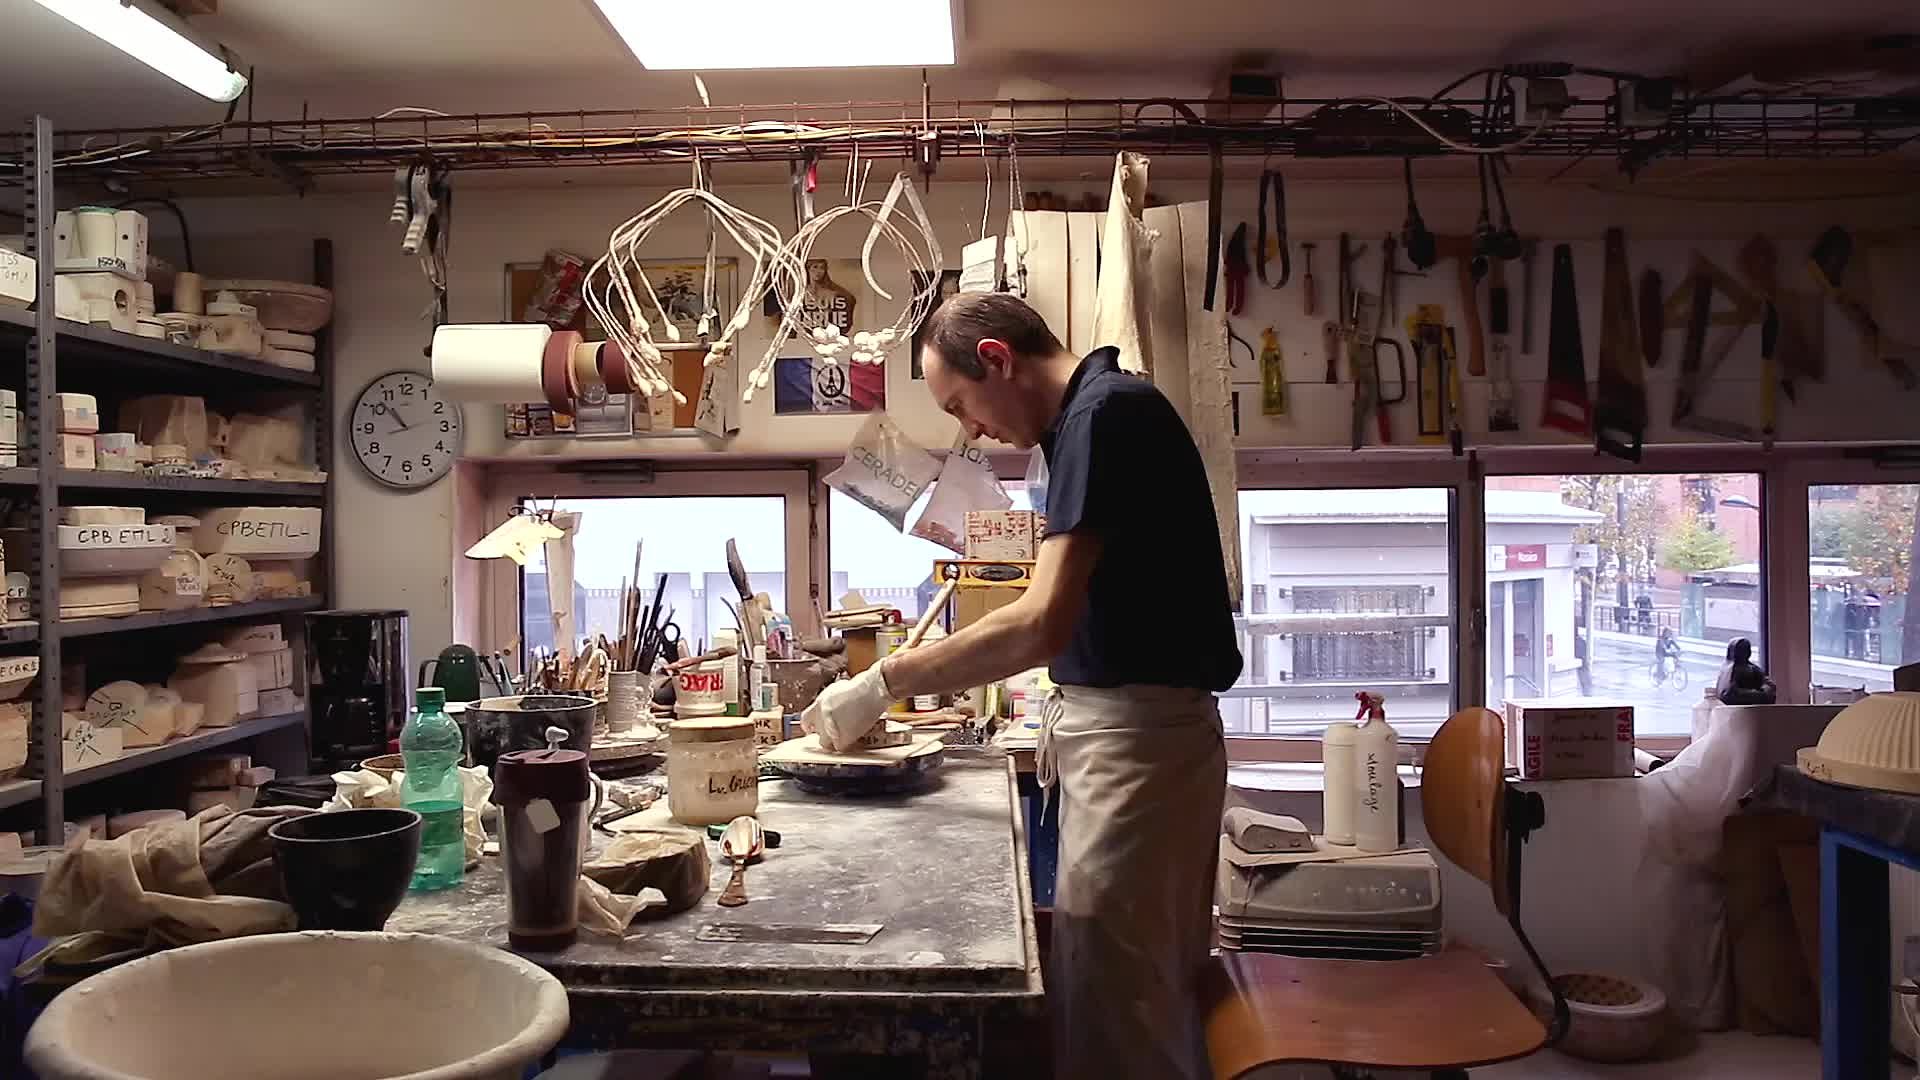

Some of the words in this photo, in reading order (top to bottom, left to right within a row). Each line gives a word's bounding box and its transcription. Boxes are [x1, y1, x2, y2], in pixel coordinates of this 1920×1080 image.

[805, 297, 847, 311] SUIS
[383, 390, 394, 401] 11
[399, 384, 413, 395] 12
[421, 389, 427, 400] 1
[370, 403, 386, 416] 10
[434, 402, 443, 414] 2
[364, 423, 374, 434] 9
[440, 420, 449, 432] 3
[370, 442, 380, 454] 8
[435, 440, 443, 453] 4
[384, 455, 392, 467] 7
[422, 454, 431, 466] 5
[402, 460, 412, 473] 6
[78, 529, 112, 543] CPB
